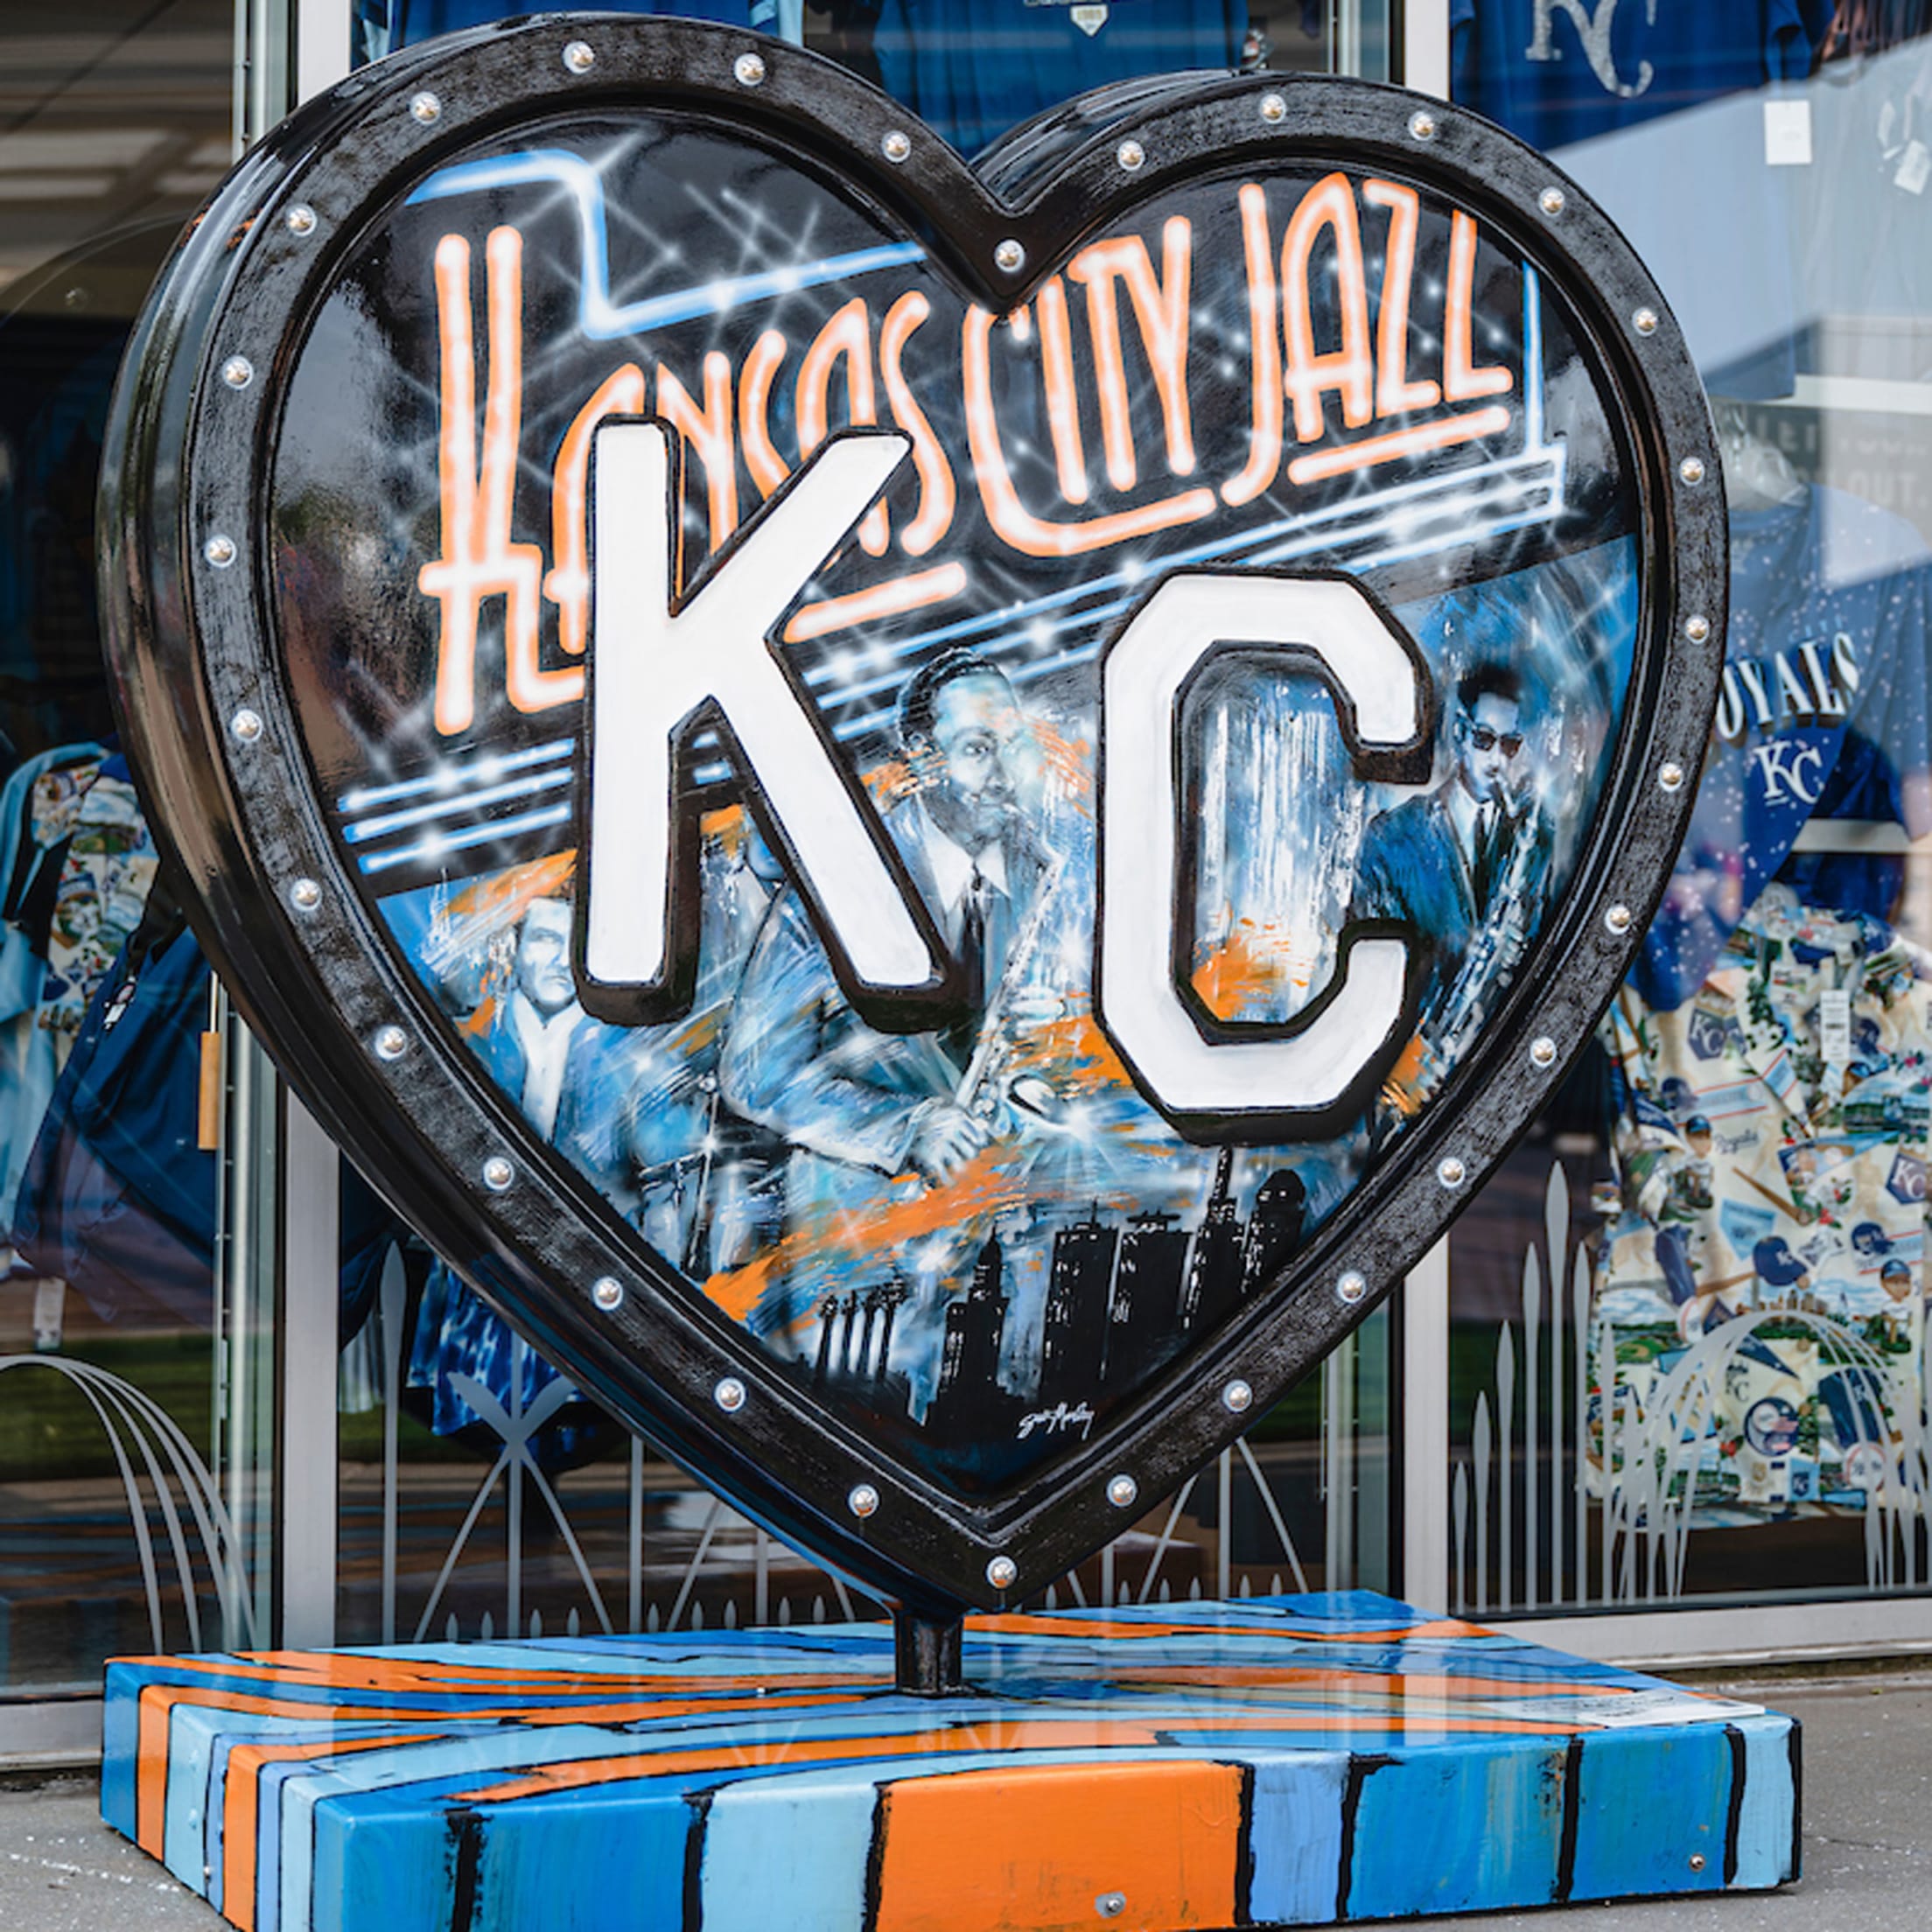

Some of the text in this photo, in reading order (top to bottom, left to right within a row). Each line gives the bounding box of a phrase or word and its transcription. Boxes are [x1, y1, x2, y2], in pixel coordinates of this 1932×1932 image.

[962, 214, 1218, 556] CITY
[1715, 630, 1860, 740] OYALS
[1752, 740, 1825, 805] KC
